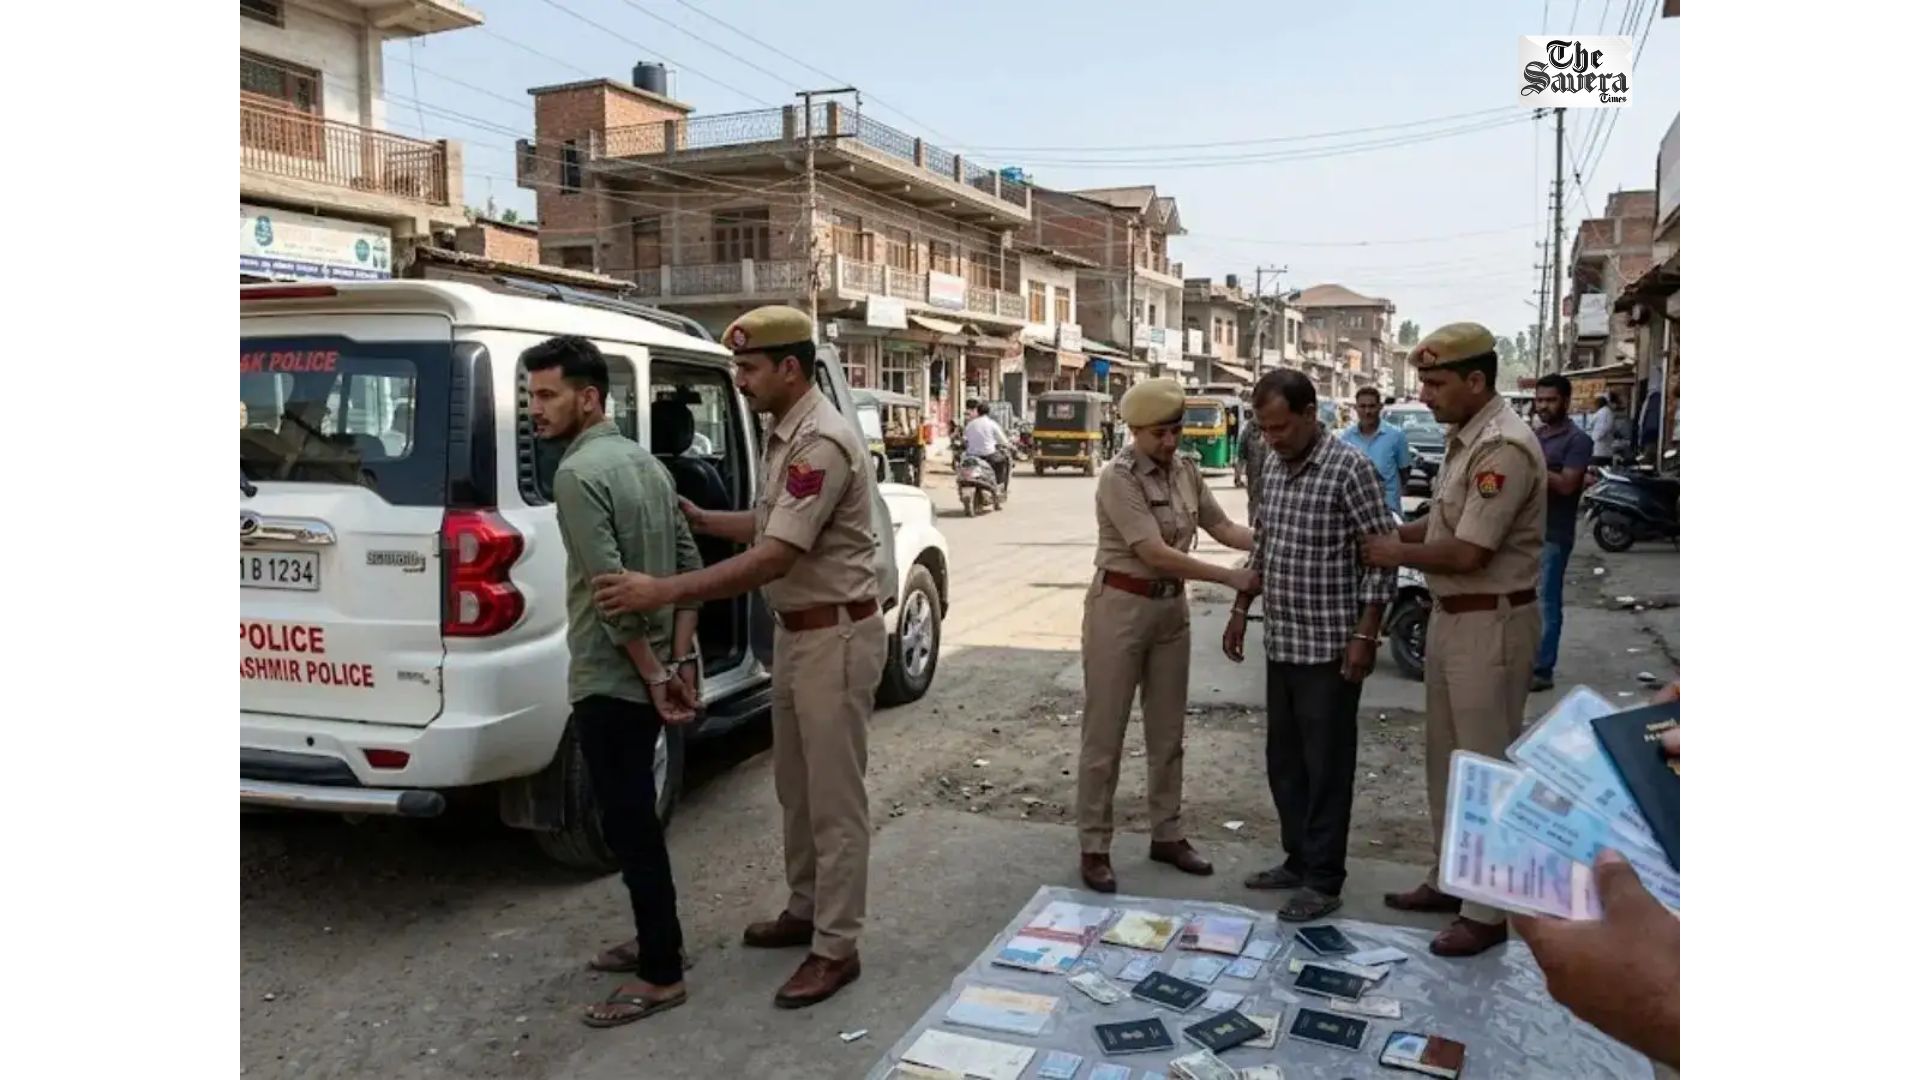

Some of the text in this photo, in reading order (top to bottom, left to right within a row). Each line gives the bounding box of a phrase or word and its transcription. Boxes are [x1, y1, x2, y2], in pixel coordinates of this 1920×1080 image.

[269, 351, 339, 372] POLICE
[252, 557, 262, 581] B
[269, 558, 314, 583] 1234
[306, 660, 375, 688] POLICE
